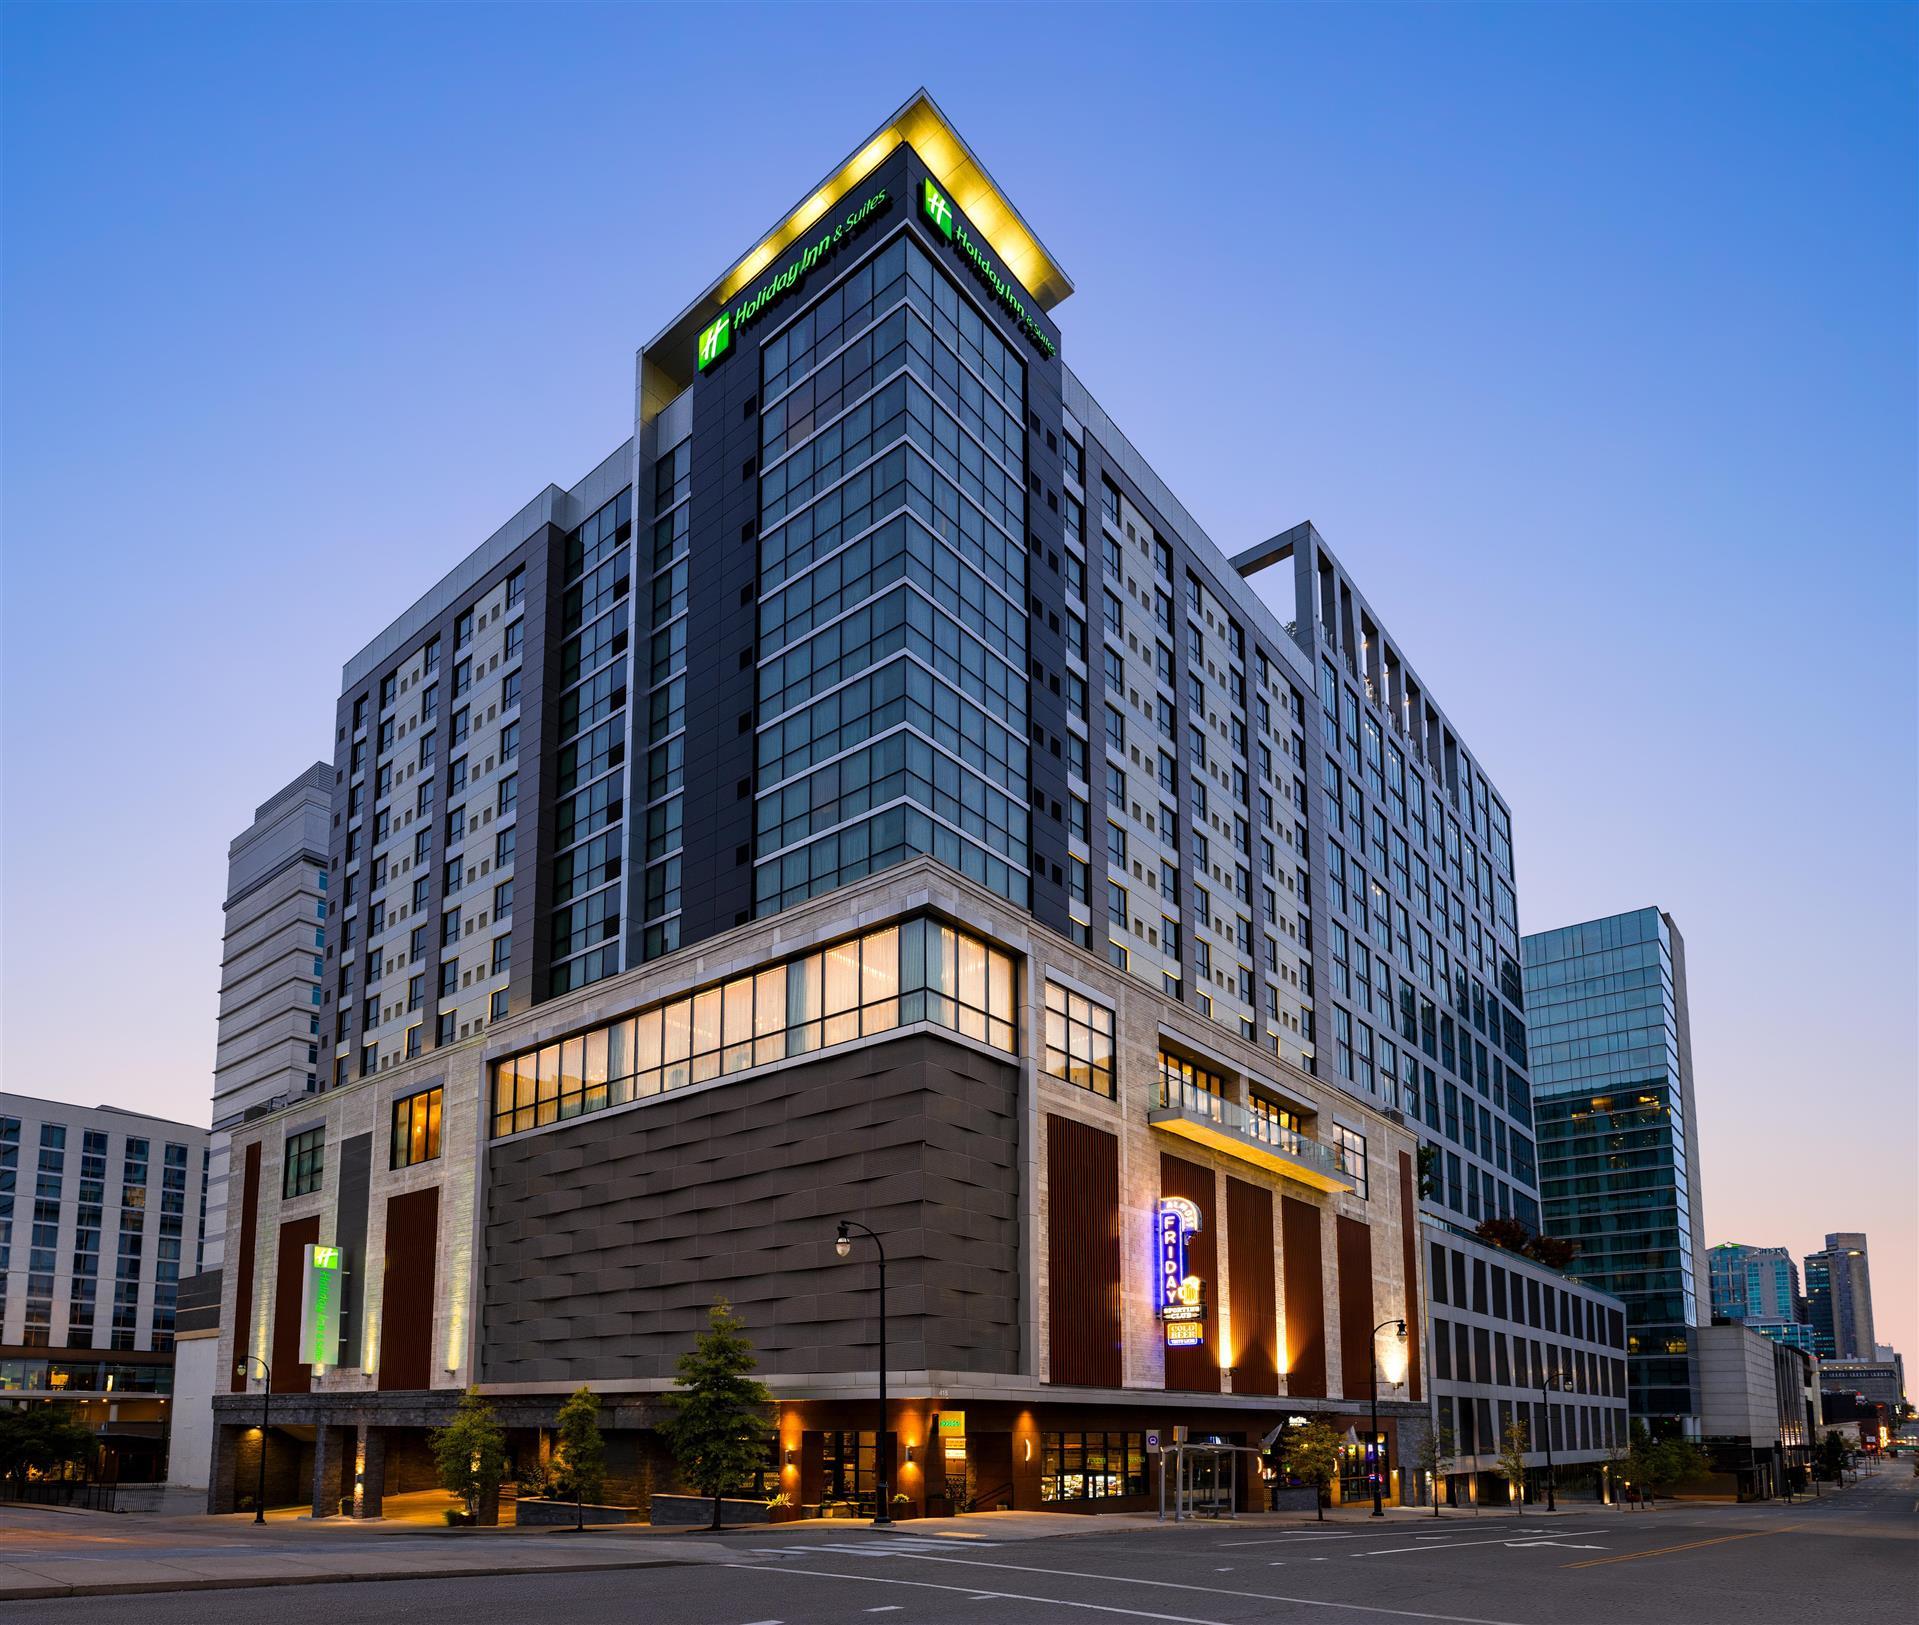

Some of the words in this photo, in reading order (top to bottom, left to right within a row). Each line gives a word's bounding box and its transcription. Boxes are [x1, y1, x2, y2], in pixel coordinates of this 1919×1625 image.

[734, 261, 800, 330] Holiday
[799, 235, 831, 272] Inn
[833, 225, 843, 242] &
[845, 189, 886, 232] Suites
[956, 225, 1004, 295] Holiday
[1006, 284, 1025, 317] Inn
[1026, 314, 1033, 327] &
[1033, 323, 1057, 357] Suites
[1166, 1200, 1194, 1228] ALMOST
[314, 1270, 331, 1313] Holiday
[1164, 1216, 1178, 1304] FRIDAY
